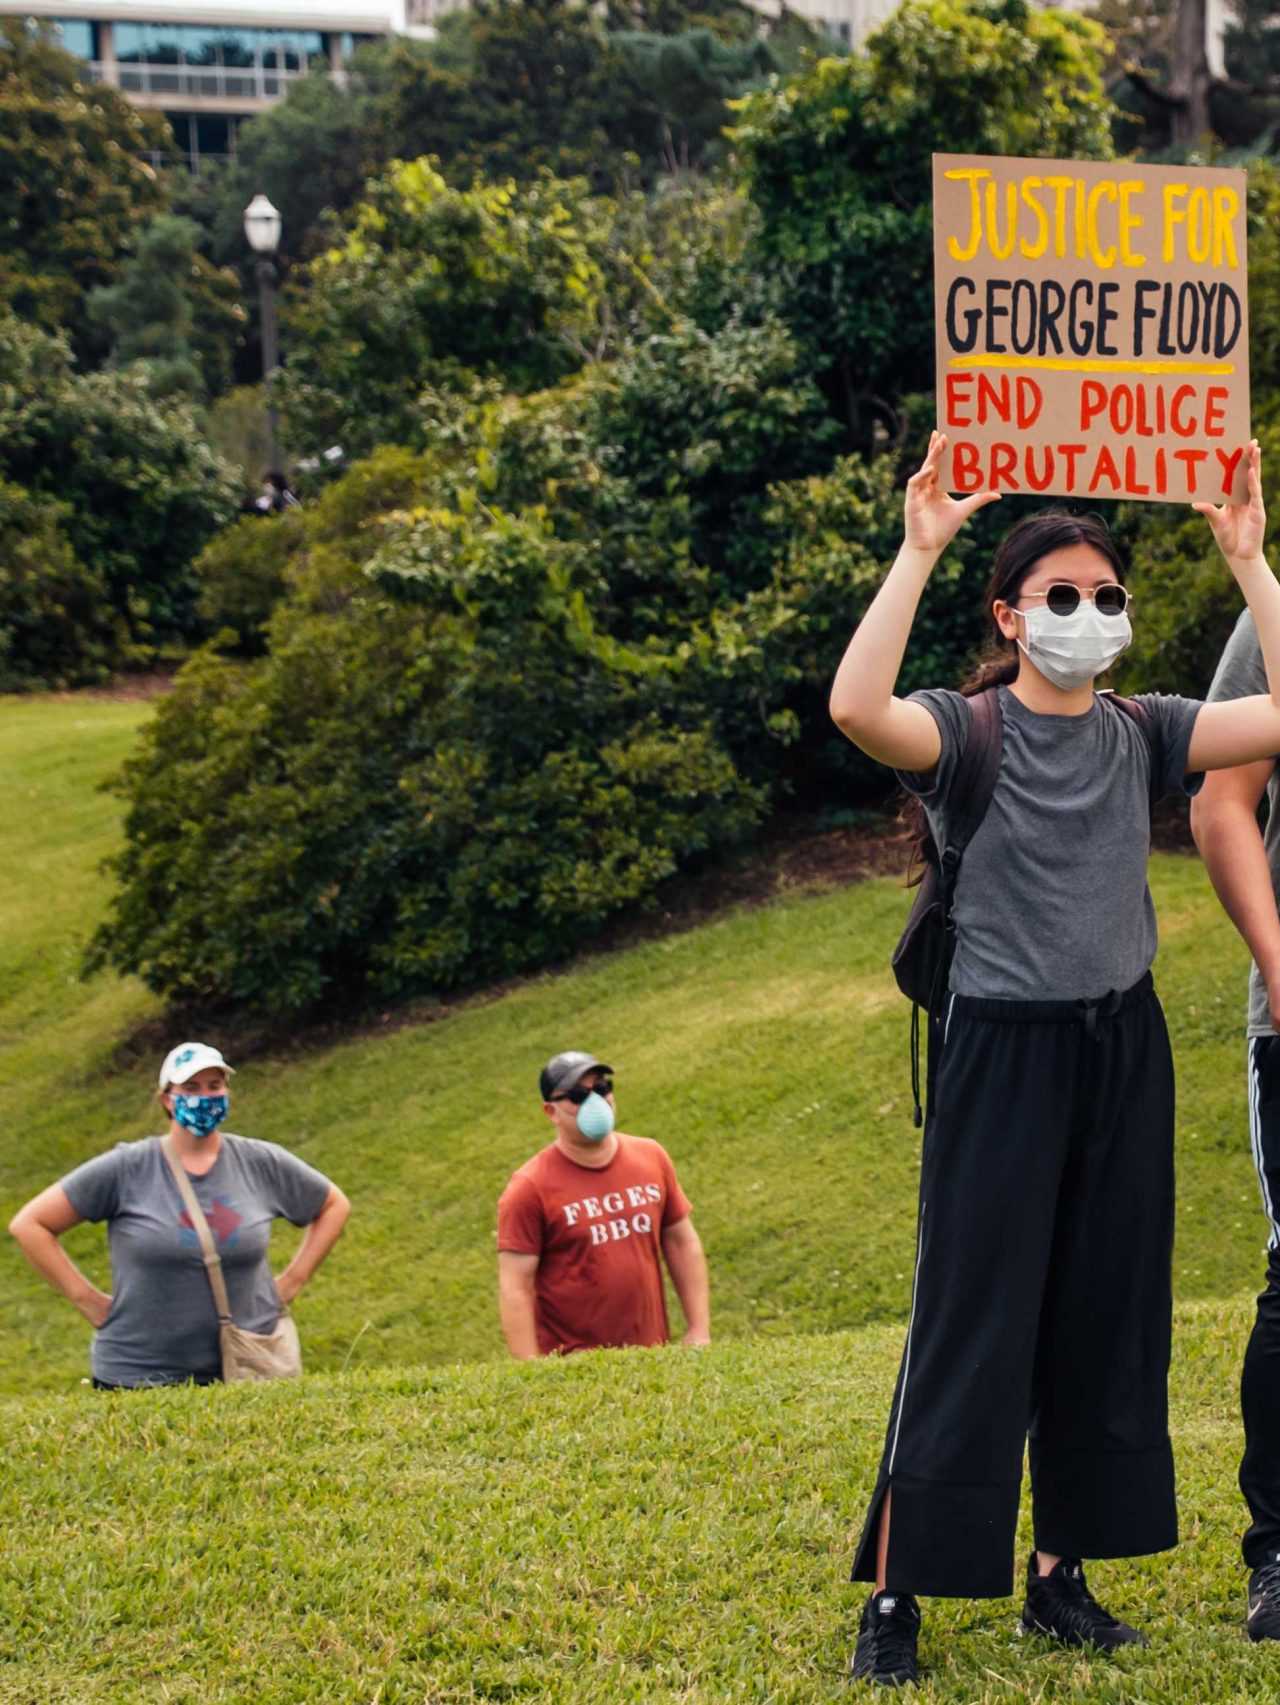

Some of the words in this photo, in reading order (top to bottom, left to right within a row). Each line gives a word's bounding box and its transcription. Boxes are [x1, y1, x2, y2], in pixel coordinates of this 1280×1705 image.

[944, 168, 1146, 268] JUSTICE
[1162, 183, 1239, 271] FOR
[945, 276, 1120, 356] GEORGE
[1133, 279, 1241, 359] FLOYD
[946, 372, 1043, 430] END
[1080, 380, 1229, 436] POLICE
[952, 442, 1244, 495] BRUTALITY
[563, 1184, 661, 1225] FEGES
[590, 1213, 651, 1245] BBQ
